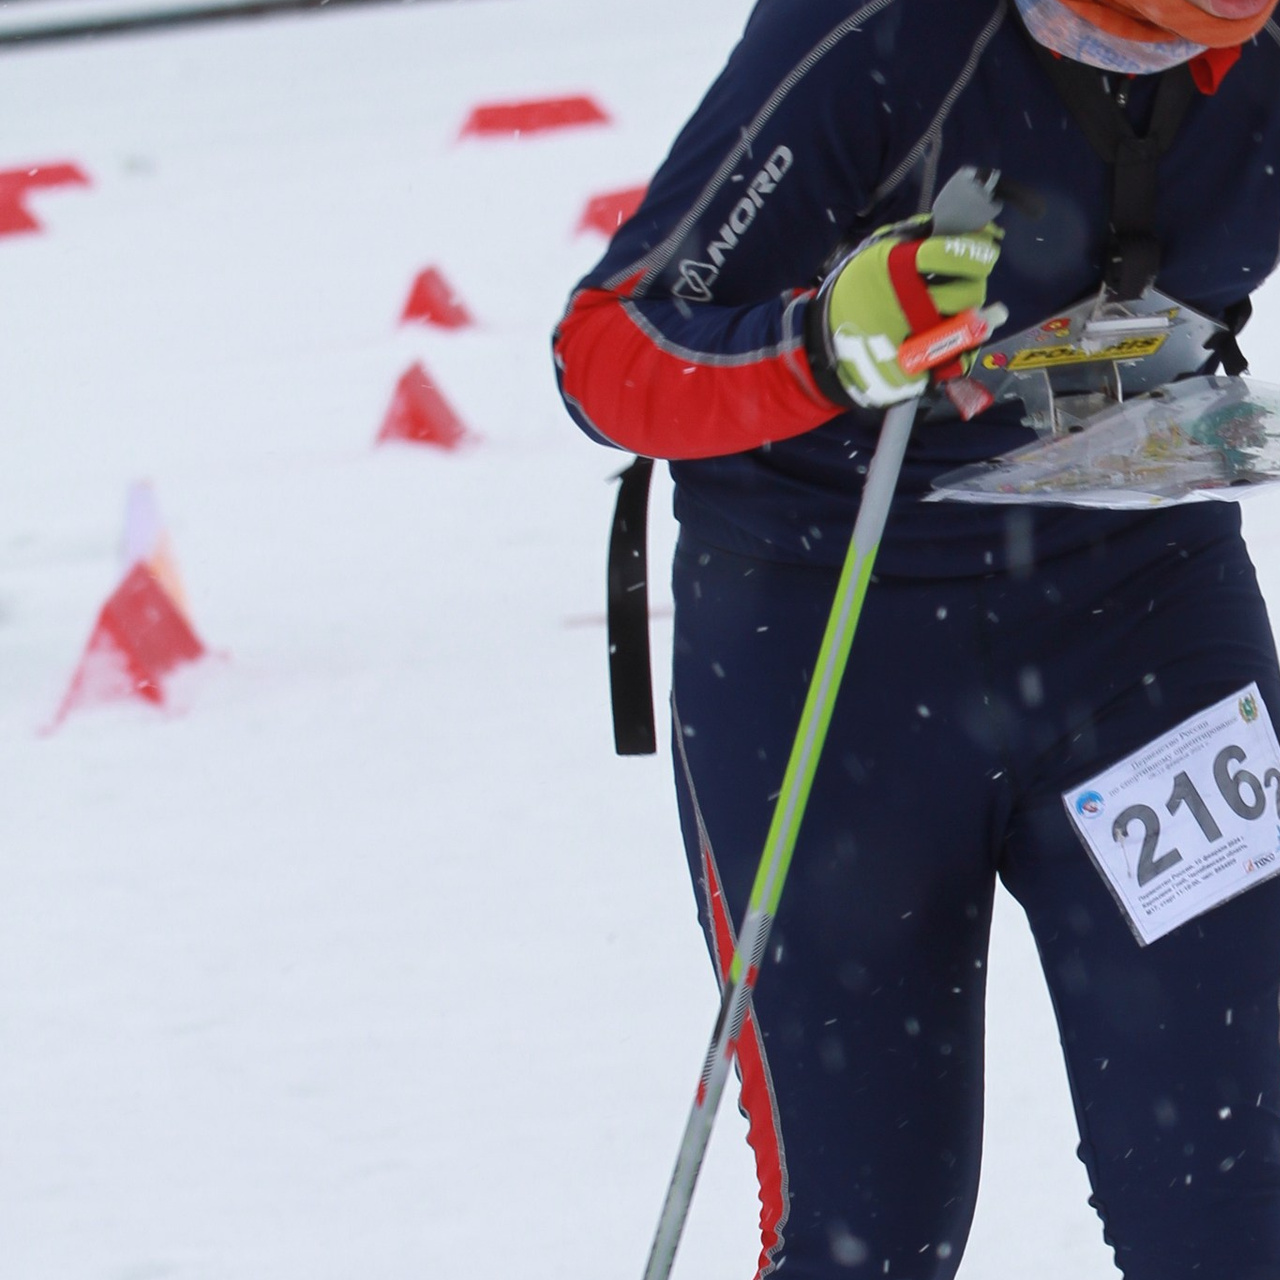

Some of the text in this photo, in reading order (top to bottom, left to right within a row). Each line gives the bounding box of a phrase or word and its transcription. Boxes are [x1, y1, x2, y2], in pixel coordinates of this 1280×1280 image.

[707, 145, 794, 267] NORD
[1130, 721, 1209, 770] Первенство России
[1112, 745, 1266, 887] 216
